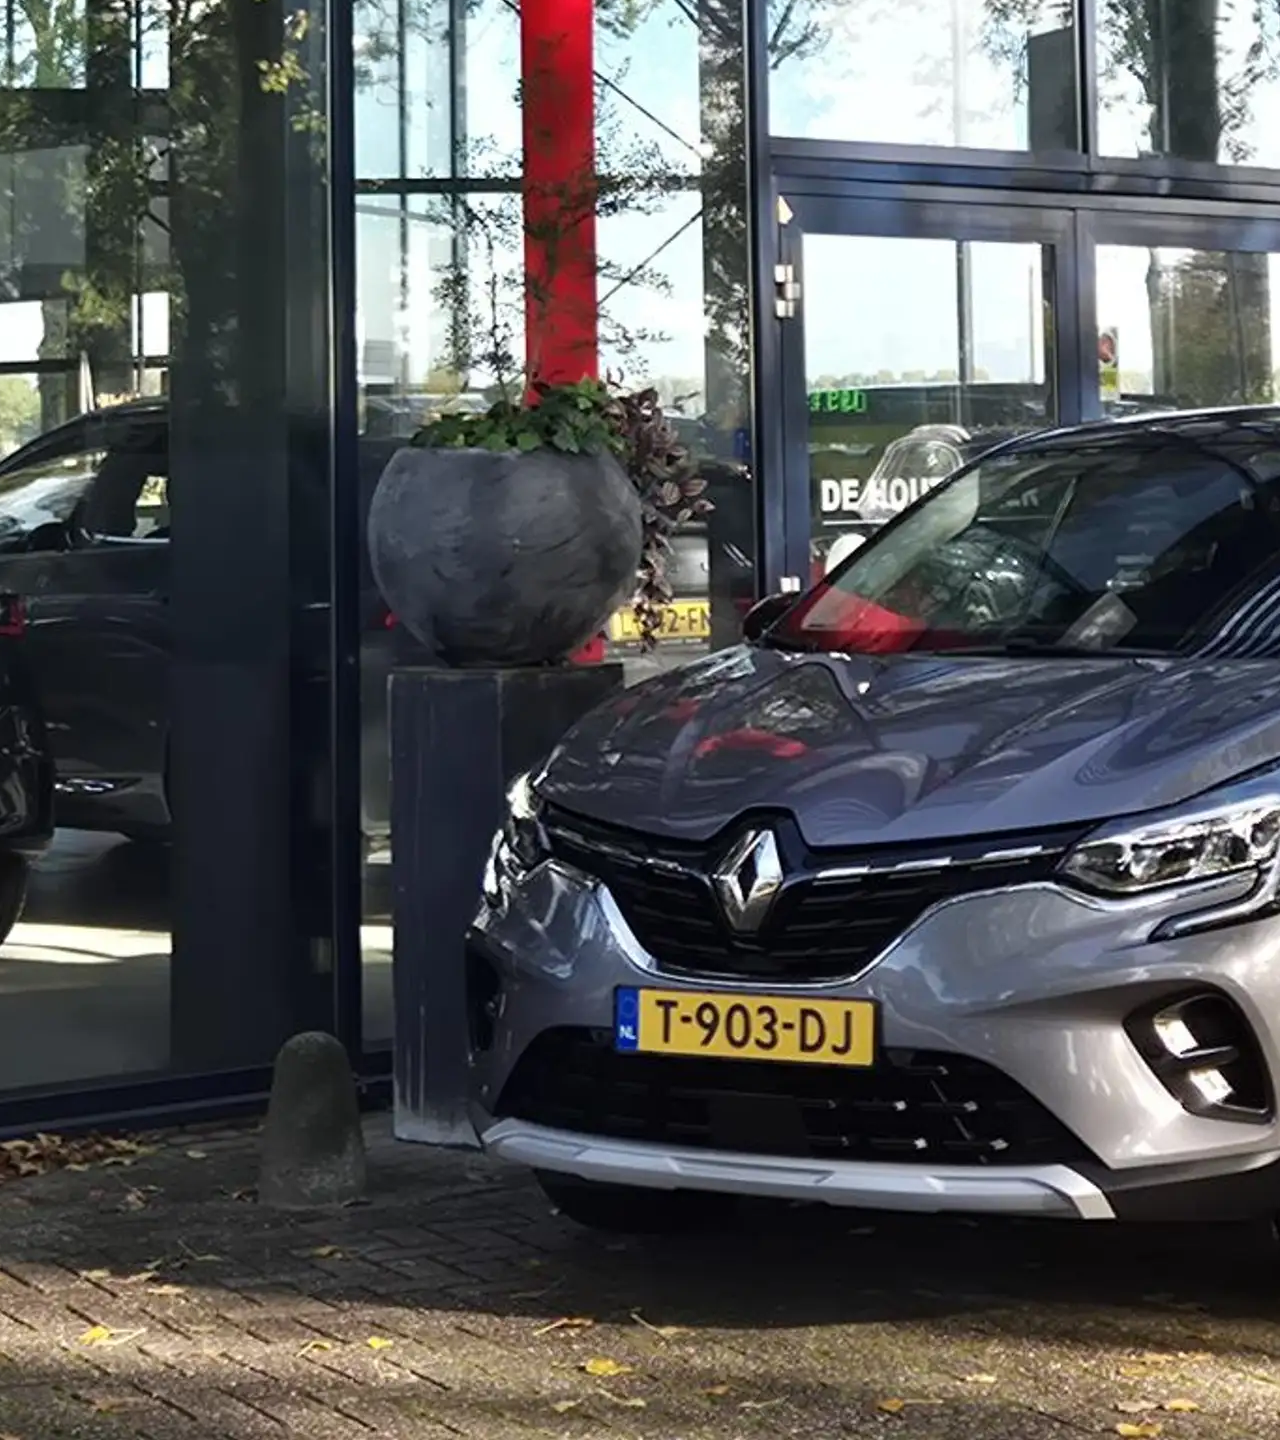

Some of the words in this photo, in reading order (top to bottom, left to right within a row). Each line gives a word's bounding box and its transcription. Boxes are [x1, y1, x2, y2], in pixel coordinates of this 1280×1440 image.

[821, 479, 860, 512] DE
[619, 1024, 637, 1041] NL
[655, 999, 853, 1056] T-903-DJ
